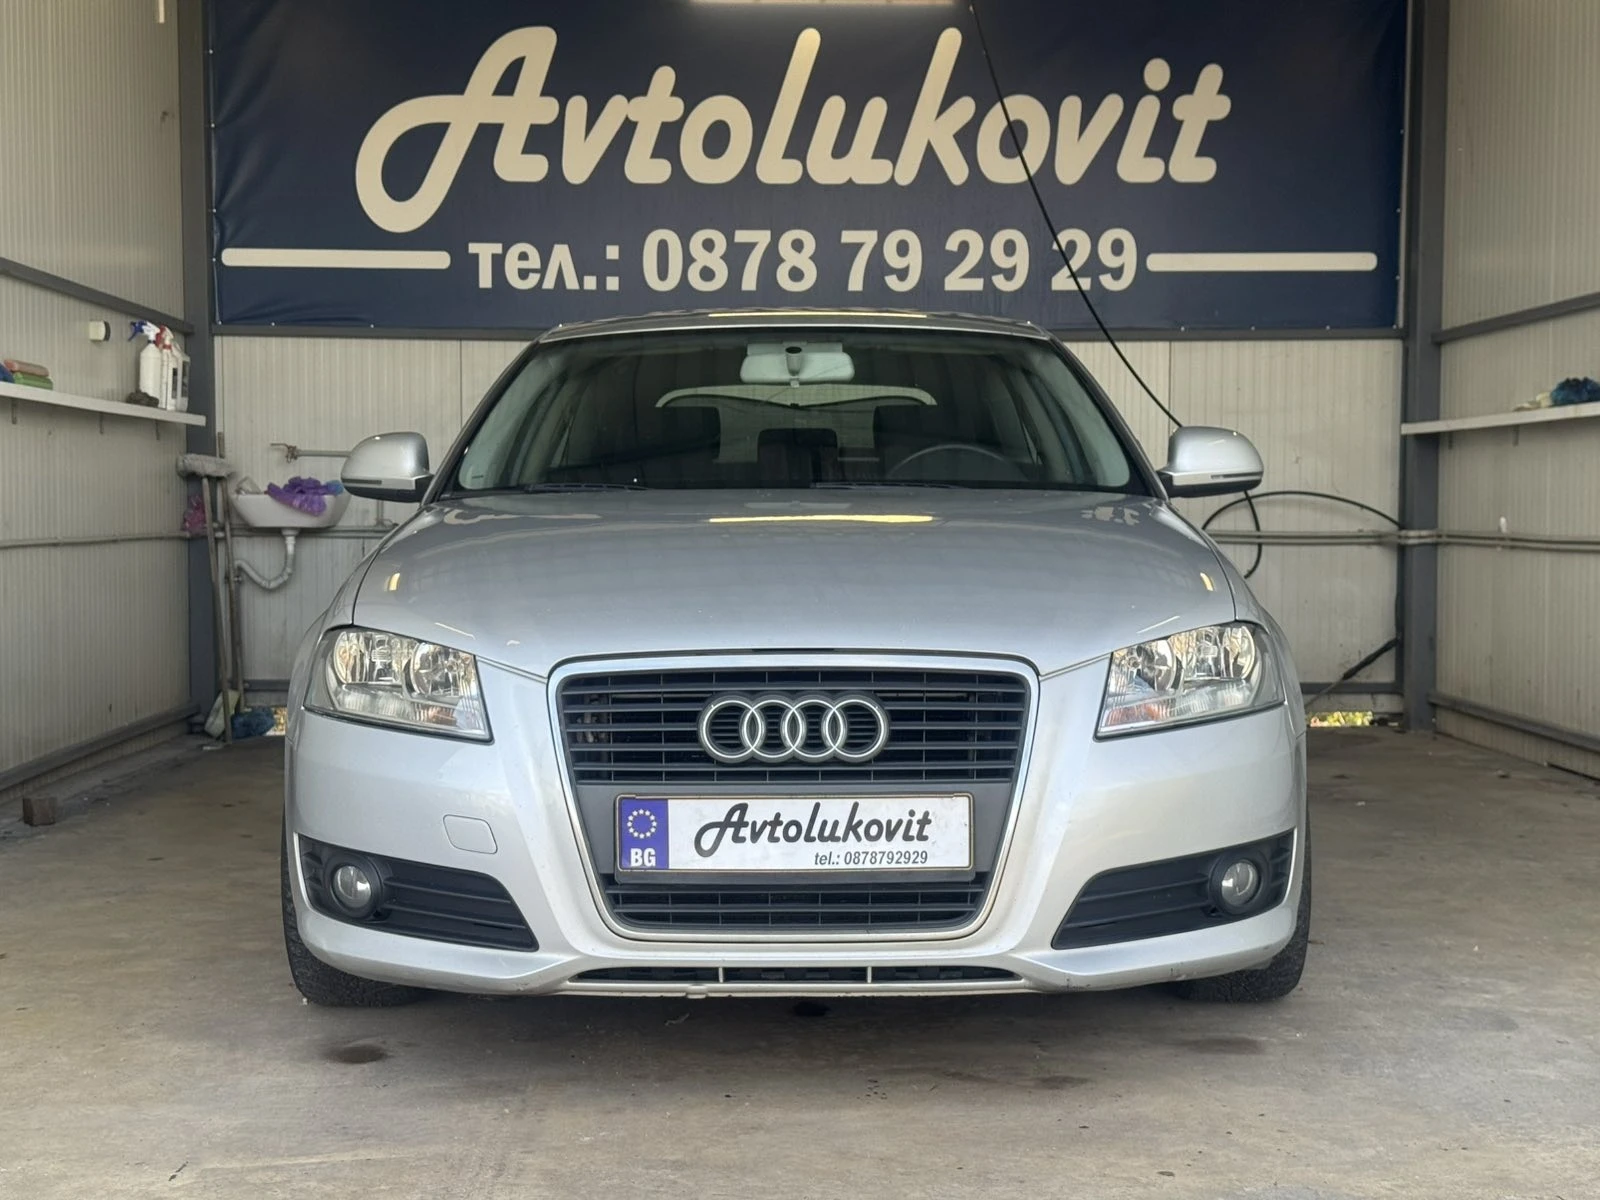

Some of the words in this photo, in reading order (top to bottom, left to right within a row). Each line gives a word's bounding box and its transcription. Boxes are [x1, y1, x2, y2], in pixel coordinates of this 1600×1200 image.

[355, 26, 1232, 234] Avtolukovit
[467, 242, 620, 292] тел.:
[642, 228, 818, 293] 0878
[840, 229, 923, 293] 79
[943, 228, 1031, 293] 29
[1050, 227, 1138, 293] 29
[694, 801, 932, 857] Avtolukovit
[629, 848, 656, 867] BG
[814, 851, 841, 866] tel.:
[843, 850, 929, 866] 0878792929
